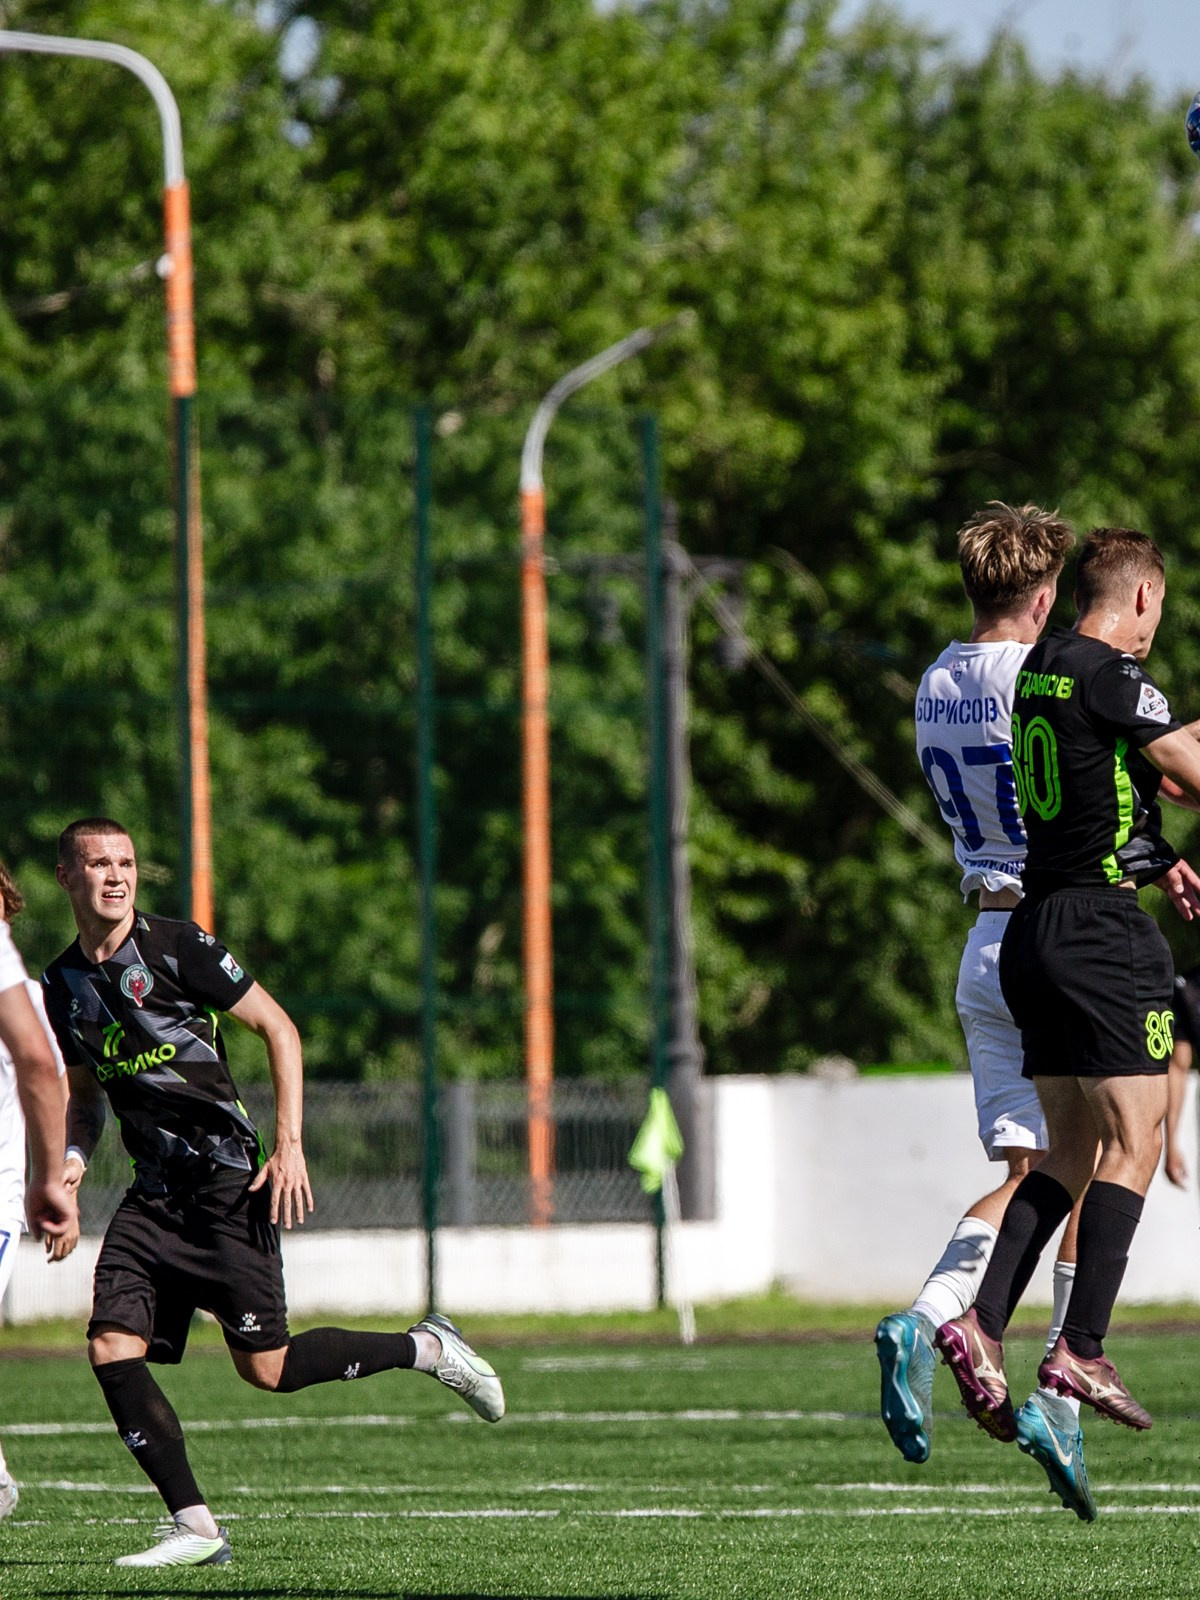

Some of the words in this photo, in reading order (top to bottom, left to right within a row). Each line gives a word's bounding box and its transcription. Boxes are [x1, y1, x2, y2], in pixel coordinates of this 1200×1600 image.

[1015, 670, 1075, 699] ГДАНОВ
[916, 697, 998, 725] БОРИСОВ
[921, 743, 1028, 852] 97
[1145, 1010, 1174, 1060] 80
